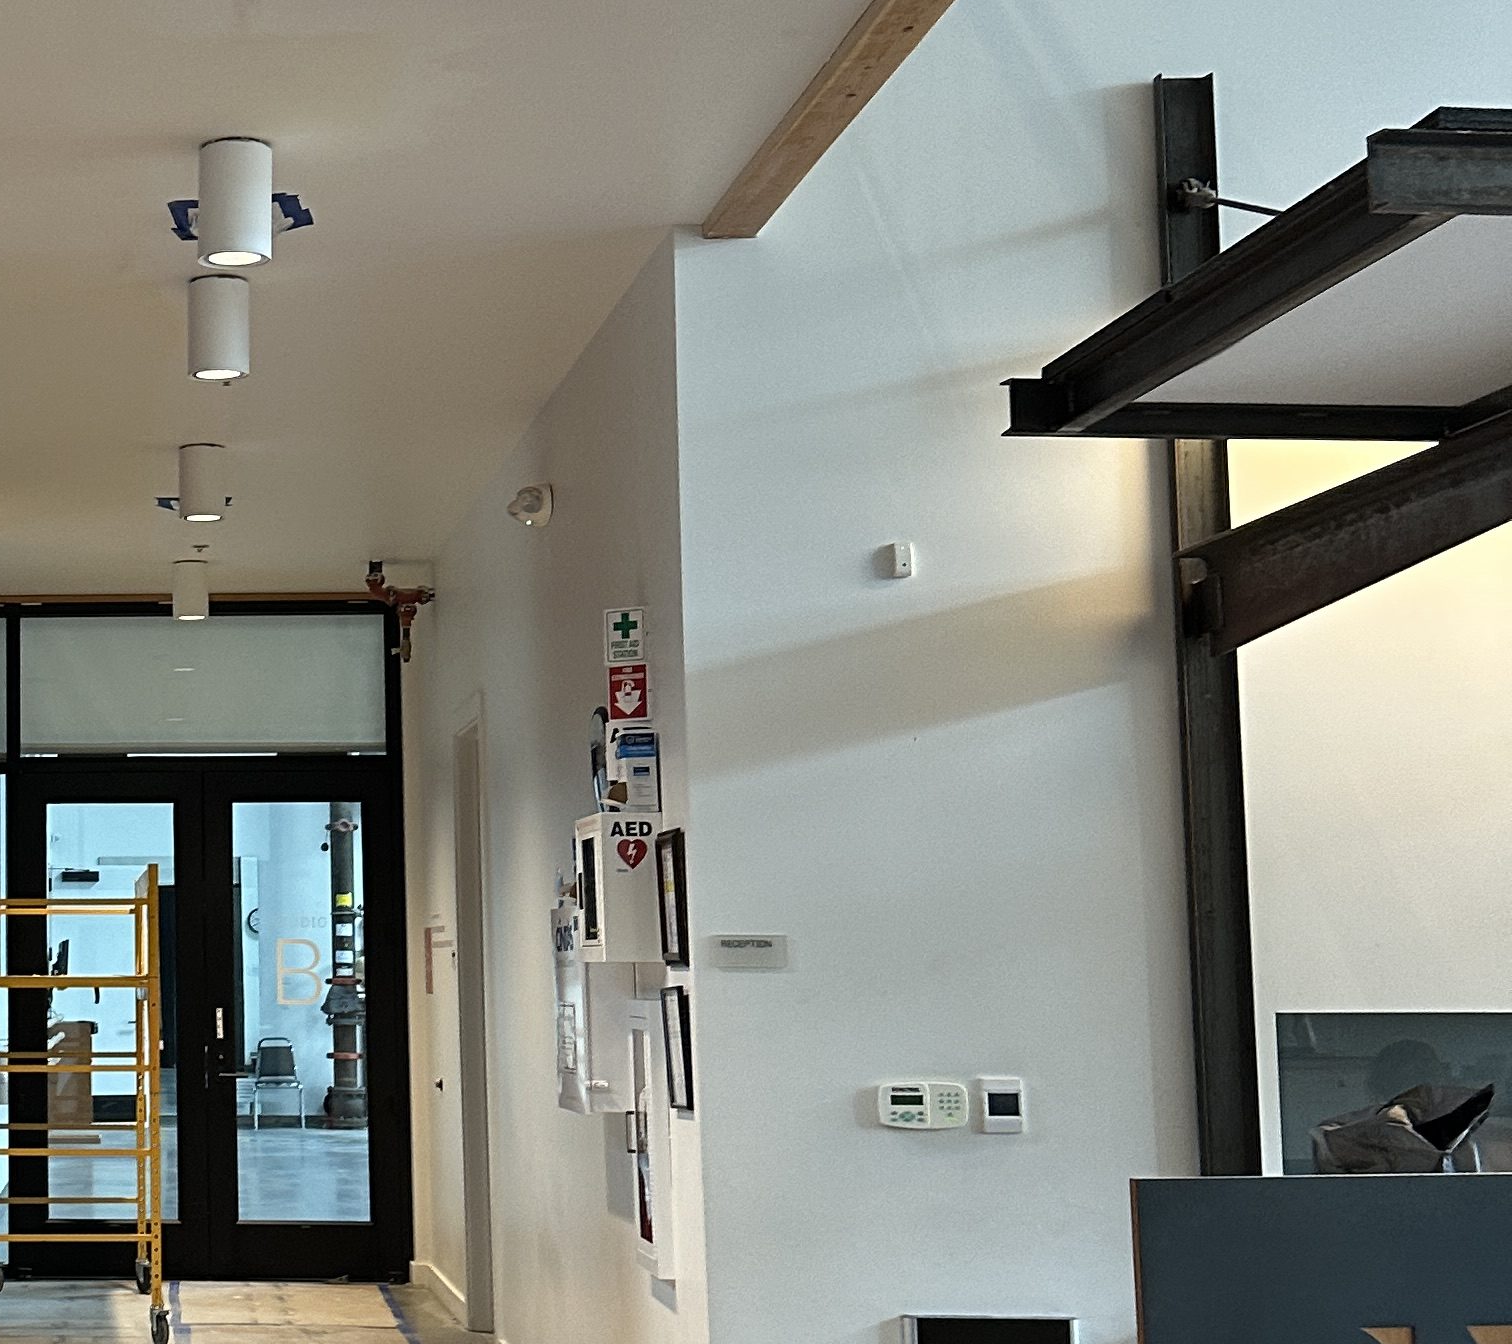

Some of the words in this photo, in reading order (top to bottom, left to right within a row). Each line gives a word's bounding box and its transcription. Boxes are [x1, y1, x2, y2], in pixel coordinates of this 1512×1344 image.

[610, 821, 652, 837] AED
[720, 939, 773, 949] RECEPTION
[275, 937, 323, 1005] B
